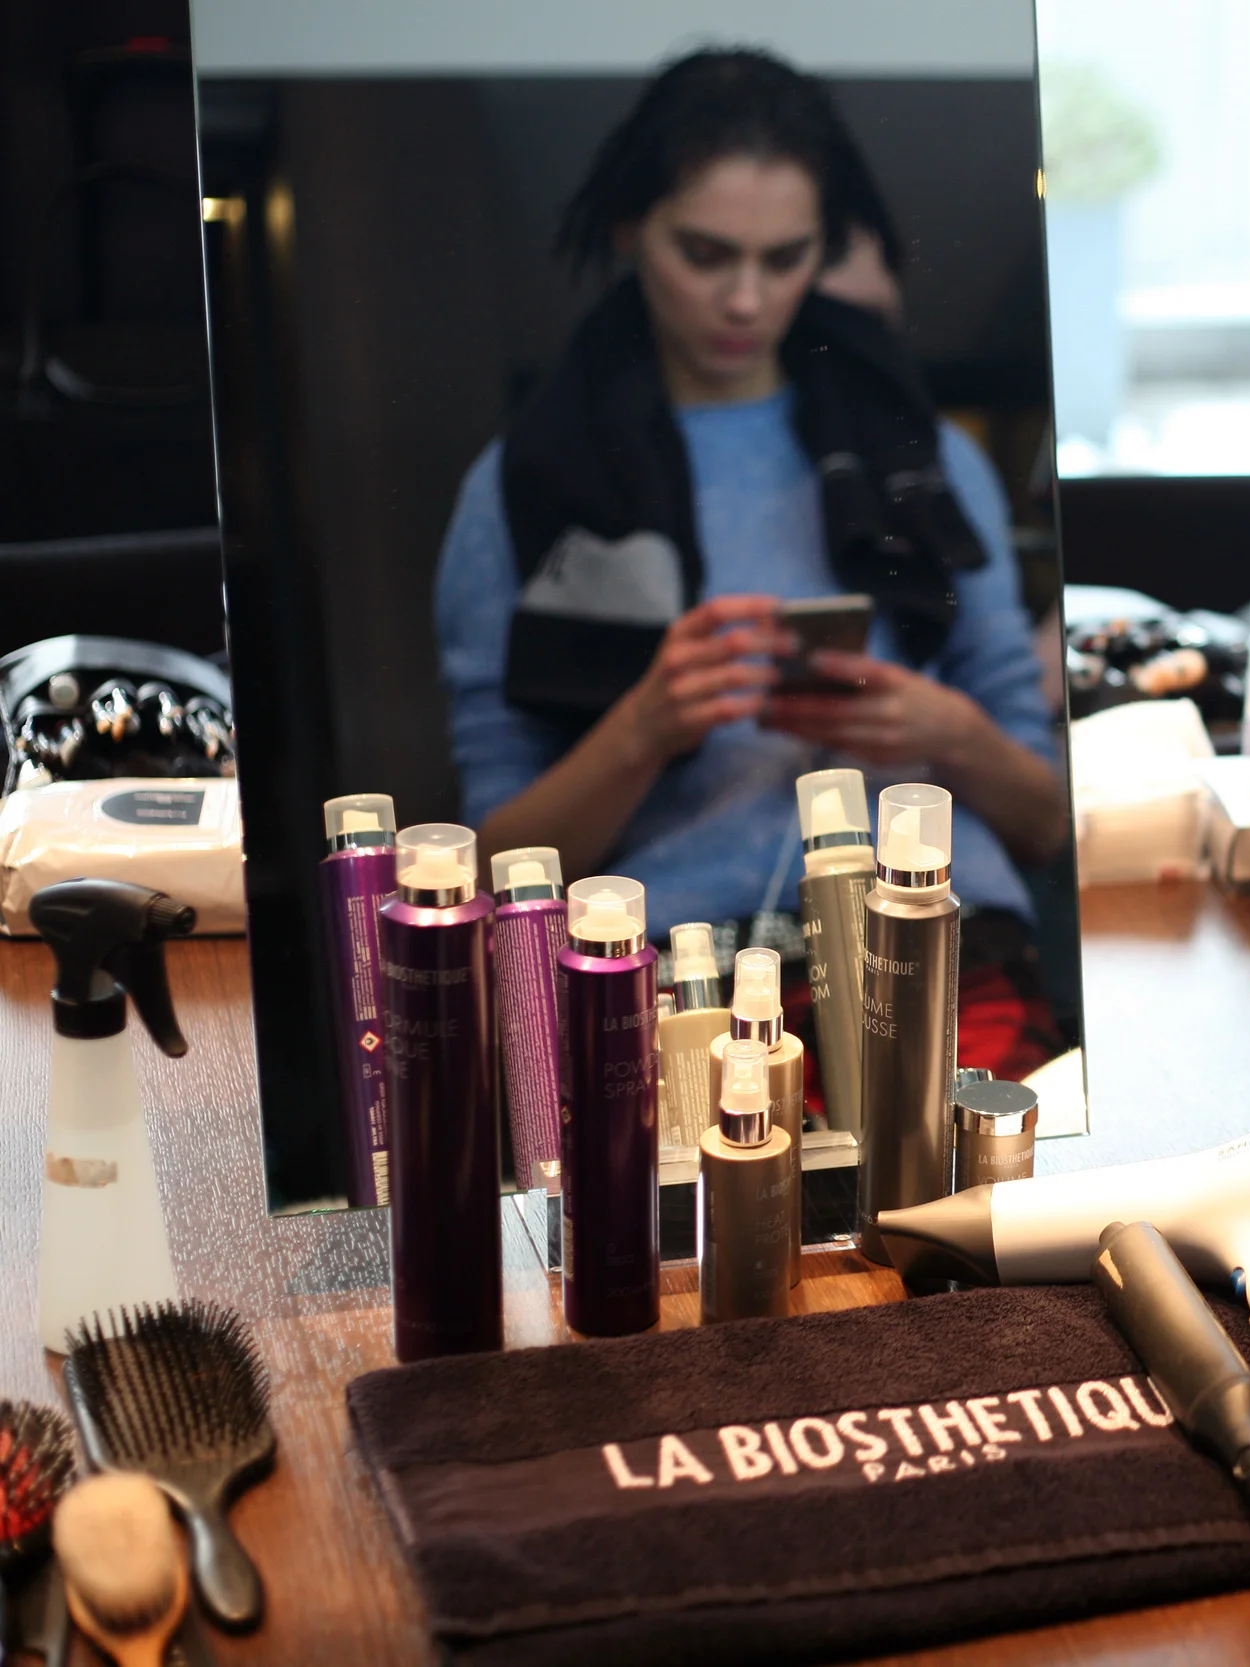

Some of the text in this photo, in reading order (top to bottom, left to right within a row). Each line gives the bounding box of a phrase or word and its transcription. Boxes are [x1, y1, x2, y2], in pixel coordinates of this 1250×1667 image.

[864, 993, 894, 1019] UME
[603, 1017, 619, 1032] LA
[863, 1015, 898, 1039] USSE
[978, 1154, 988, 1165] LA
[602, 1434, 713, 1488] LA
[862, 1442, 1008, 1482] PARIS
